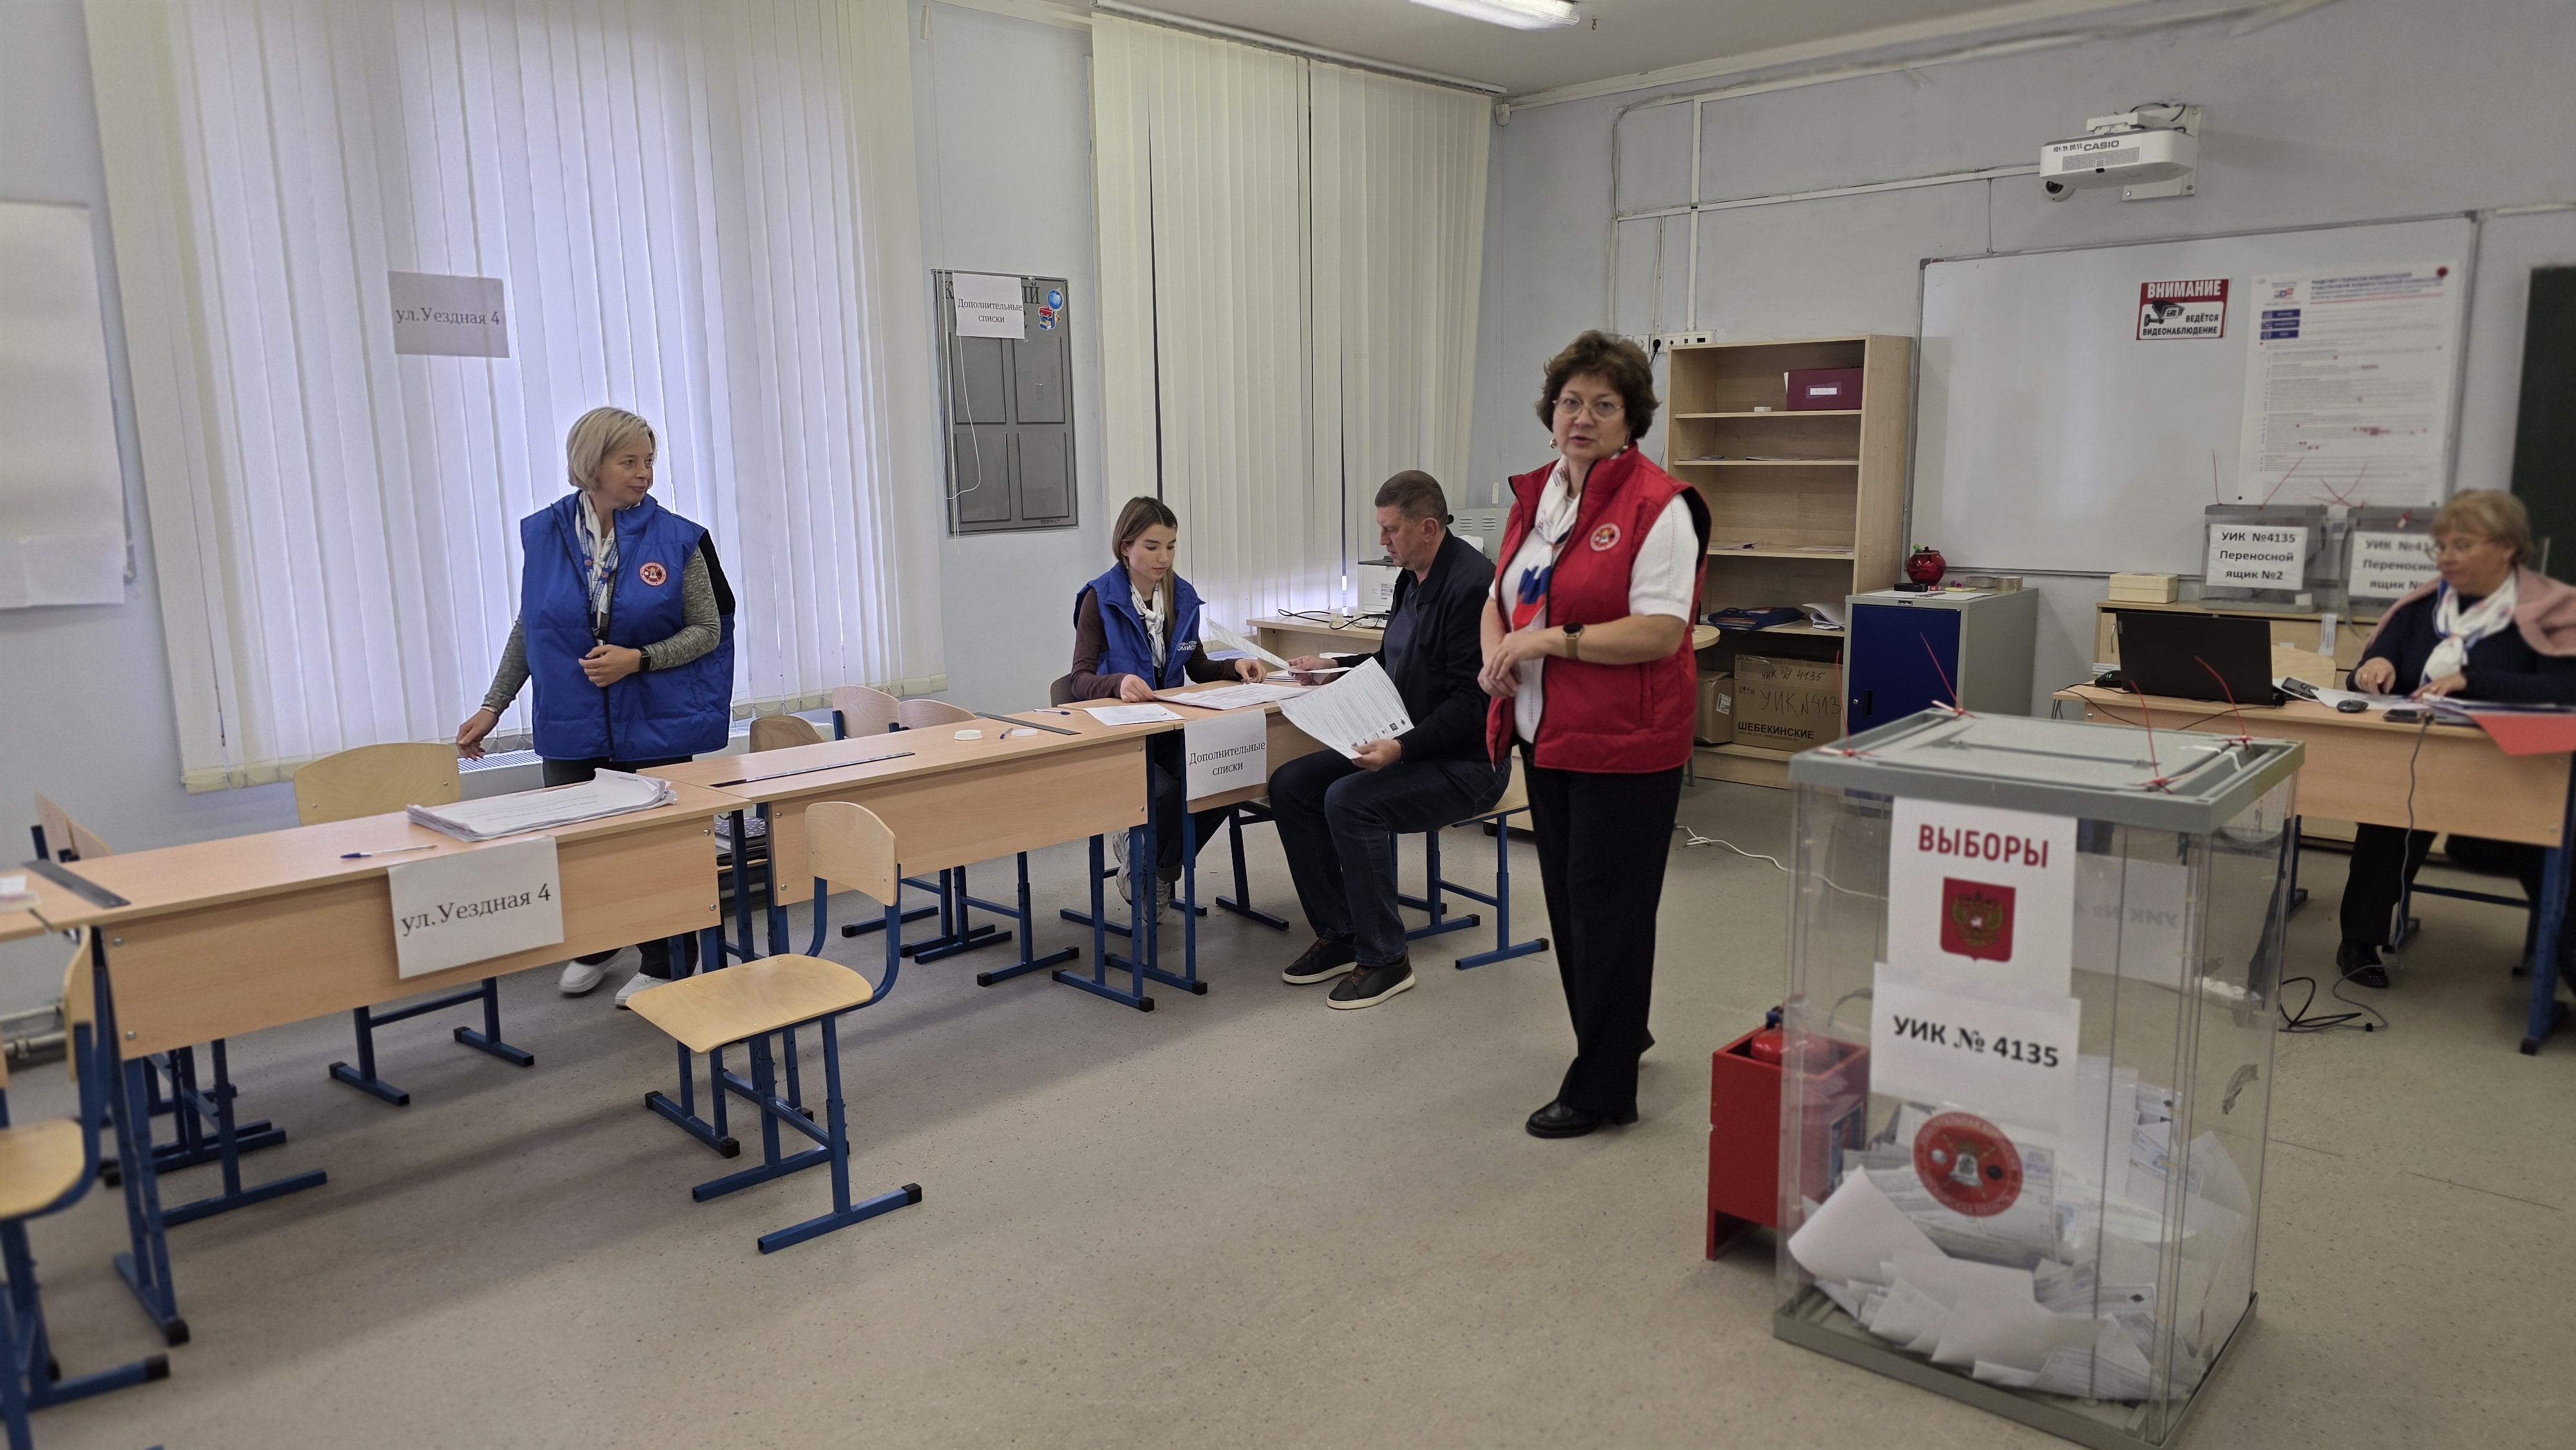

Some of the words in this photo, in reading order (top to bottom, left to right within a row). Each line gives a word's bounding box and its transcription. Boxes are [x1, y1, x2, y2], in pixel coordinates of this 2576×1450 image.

[2084, 140, 2119, 151] CASIO
[2147, 280, 2221, 299] ВНИМАНИЕ
[958, 298, 1023, 311] Дополнительные
[396, 307, 487, 325] ул.Уездная
[491, 311, 500, 325] 4
[978, 315, 1005, 323] списки
[2186, 312, 2219, 323] ВЕДЁТСЯ
[2143, 326, 2217, 336] ВИДЕОНАБЛЮДЕНИЕ
[2222, 532, 2246, 541] УИК
[2253, 533, 2296, 543] №4135
[2366, 540, 2391, 551] УИК
[2220, 551, 2294, 561] Переносной
[2363, 559, 2439, 572] Переносно
[2226, 570, 2259, 579] ящик
[2262, 570, 2283, 580] №2
[2370, 581, 2405, 590] ящик
[1797, 670, 1826, 681] 4135
[1760, 689, 1800, 720] УИК
[1738, 721, 1815, 740] ШЕБЕКИНСКИЕ
[1189, 742, 1265, 766] Дополнительные
[1213, 762, 1243, 776] списки
[1918, 824, 2049, 868] ВЫБОРЫ
[401, 892, 531, 936] ул.Уездная
[538, 883, 551, 901] 4
[1893, 1015, 1946, 1045] УИК
[1953, 1028, 1985, 1053] №
[1993, 1037, 2059, 1068] 4135
